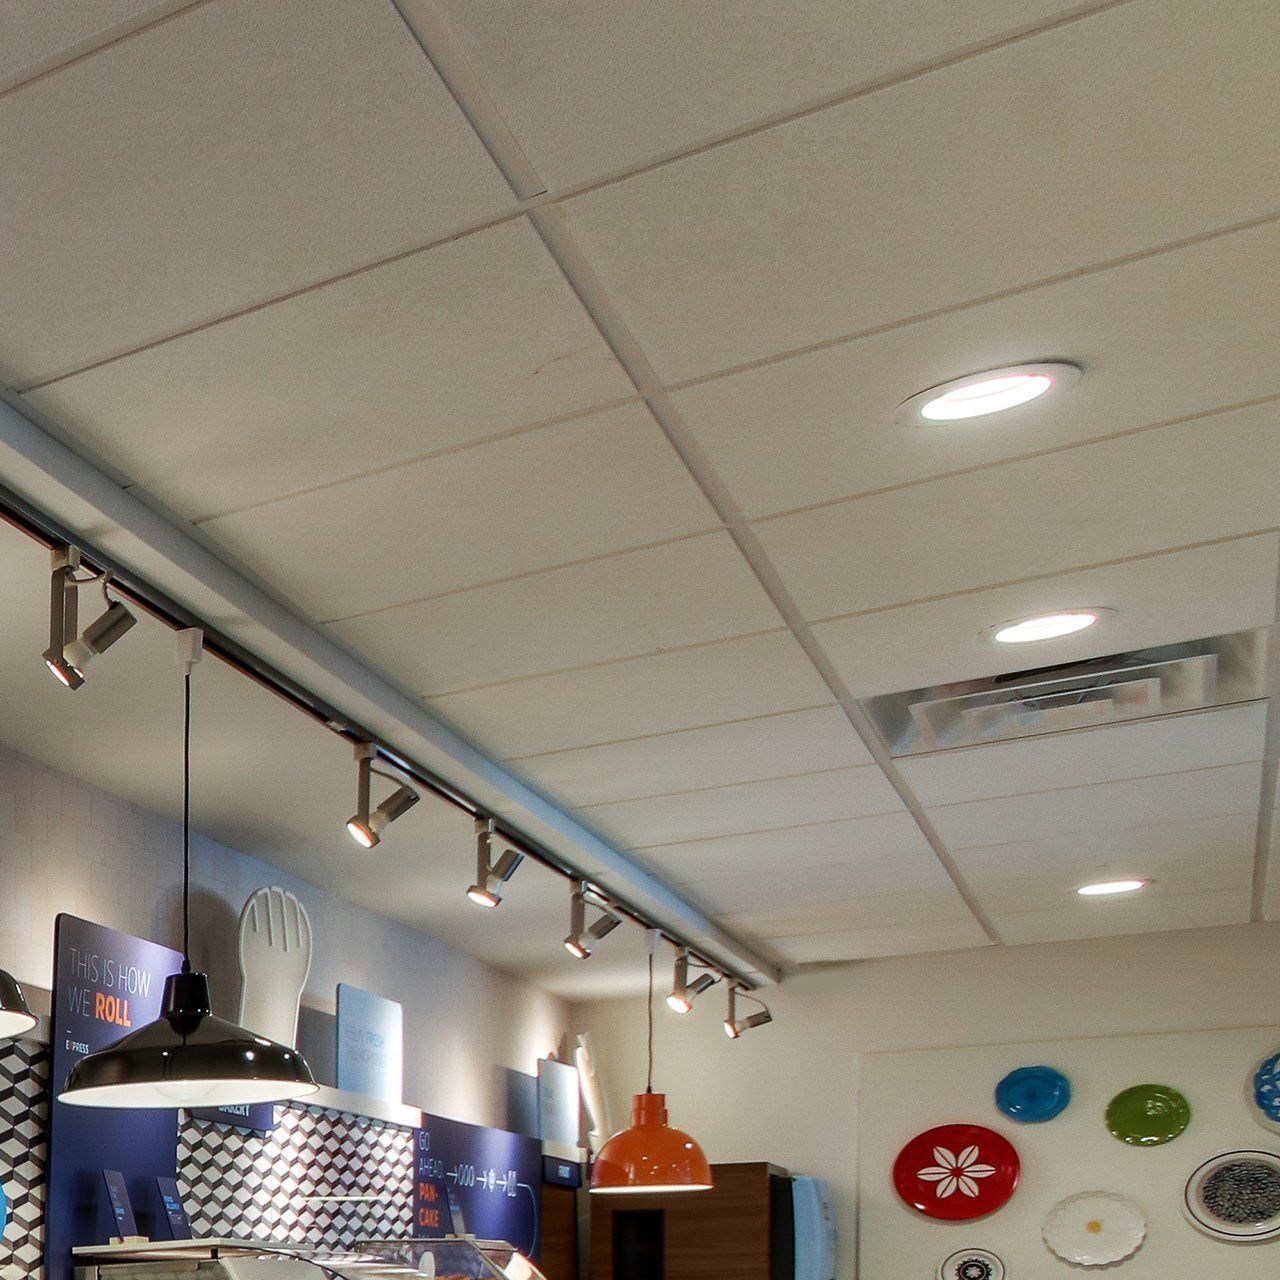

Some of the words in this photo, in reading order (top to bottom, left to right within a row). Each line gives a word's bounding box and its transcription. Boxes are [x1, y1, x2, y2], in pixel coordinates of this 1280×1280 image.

[70, 947, 99, 983] THIS
[103, 959, 114, 987] IS
[118, 963, 151, 998] HOW
[68, 985, 91, 1018] WE
[95, 992, 132, 1028] ROLL
[419, 1131, 430, 1151] GO
[418, 1157, 444, 1178] AHEAD
